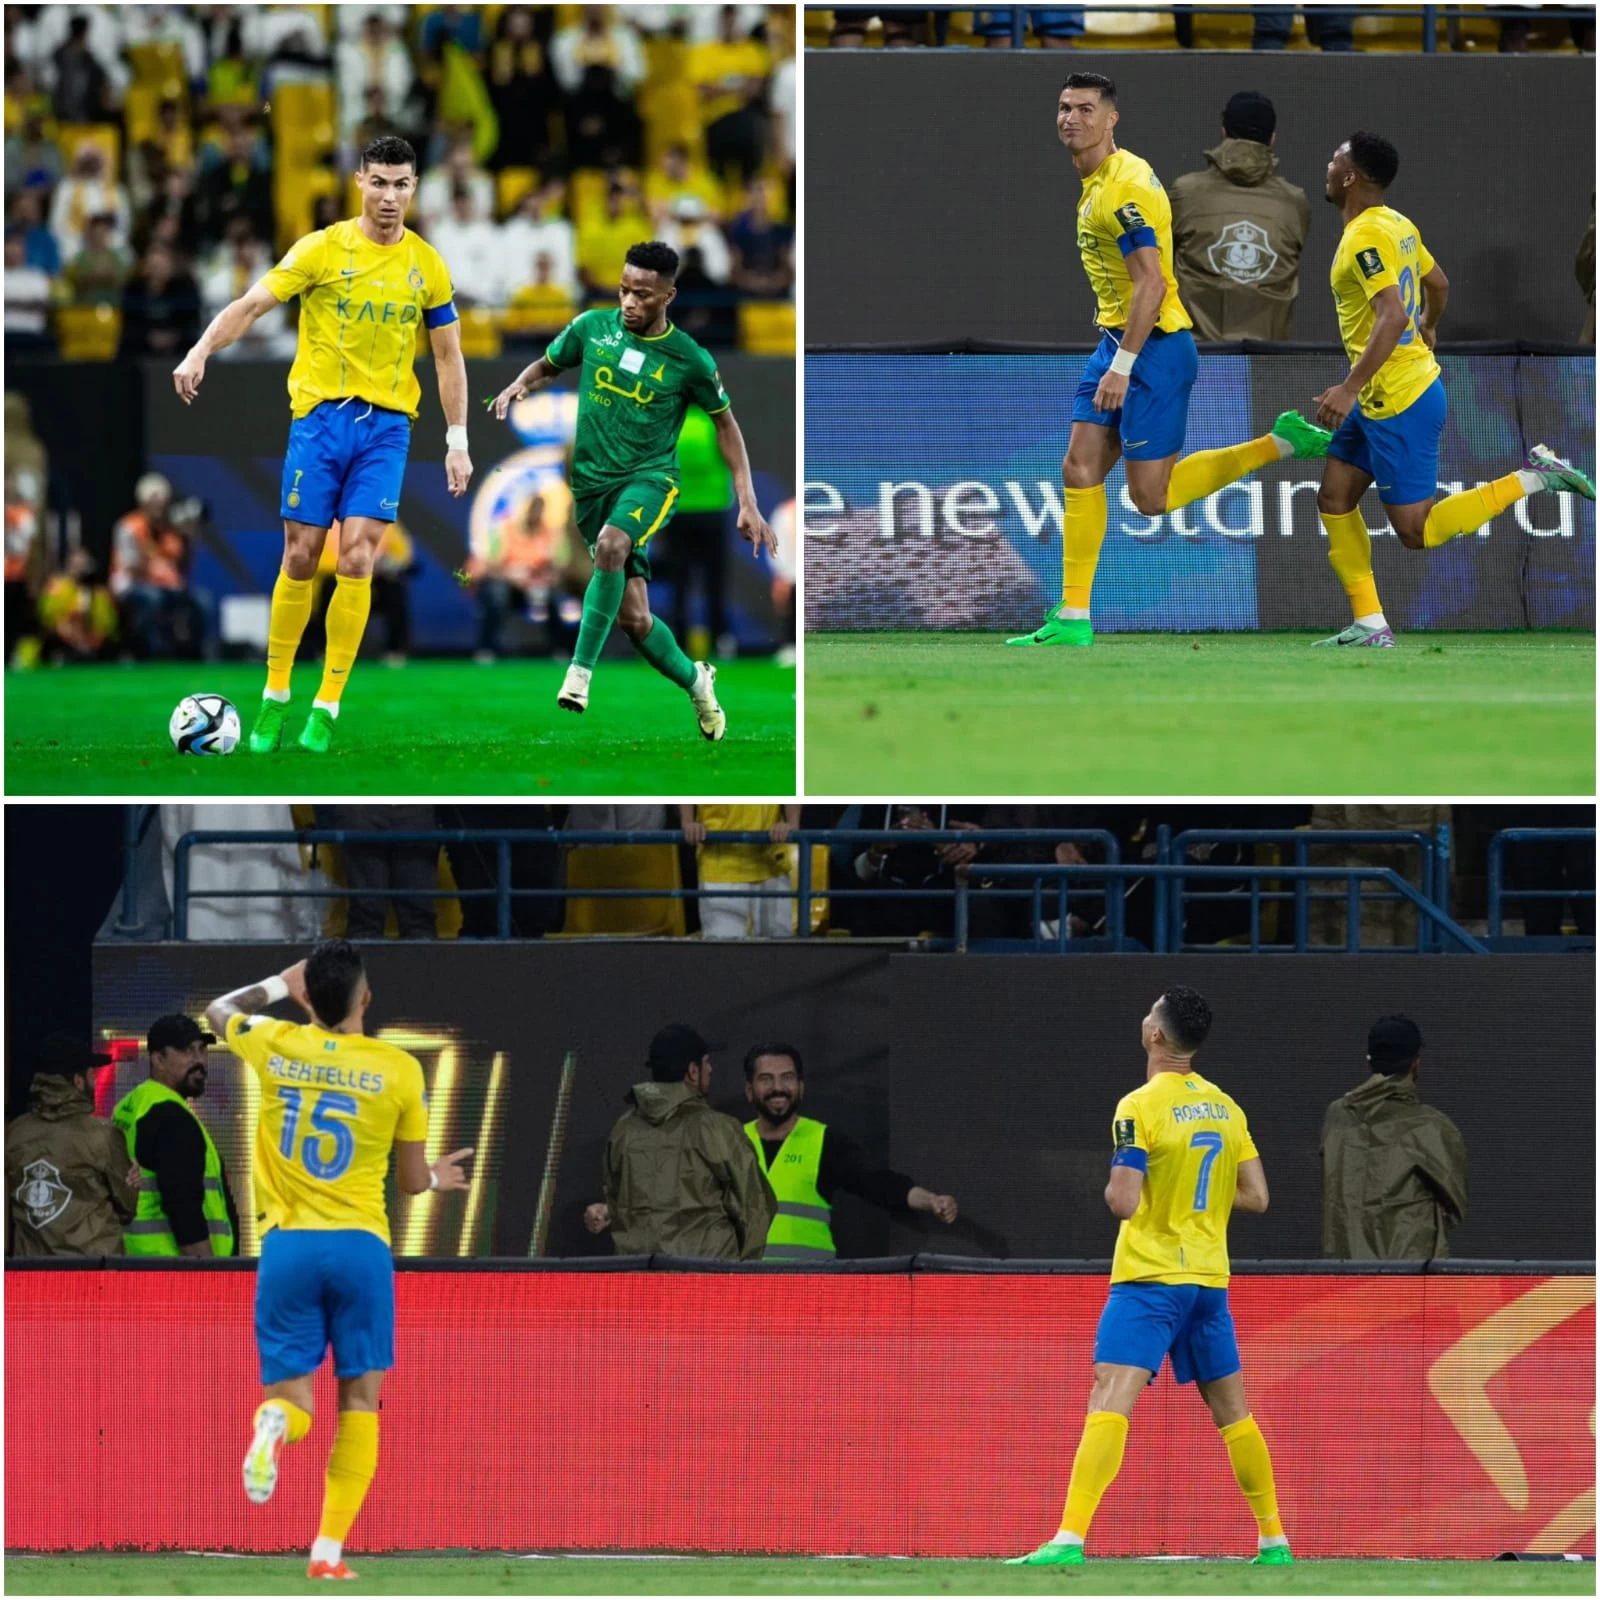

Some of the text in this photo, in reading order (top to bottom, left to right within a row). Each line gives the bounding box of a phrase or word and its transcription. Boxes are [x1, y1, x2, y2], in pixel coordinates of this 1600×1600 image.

[336, 296, 417, 324] KAFD
[588, 391, 611, 407] YELO
[294, 469, 303, 487] 7
[1172, 1102, 1229, 1123] RONALDO
[277, 1085, 358, 1181] 15
[784, 1153, 803, 1164] 201
[1190, 1131, 1223, 1211] 7
